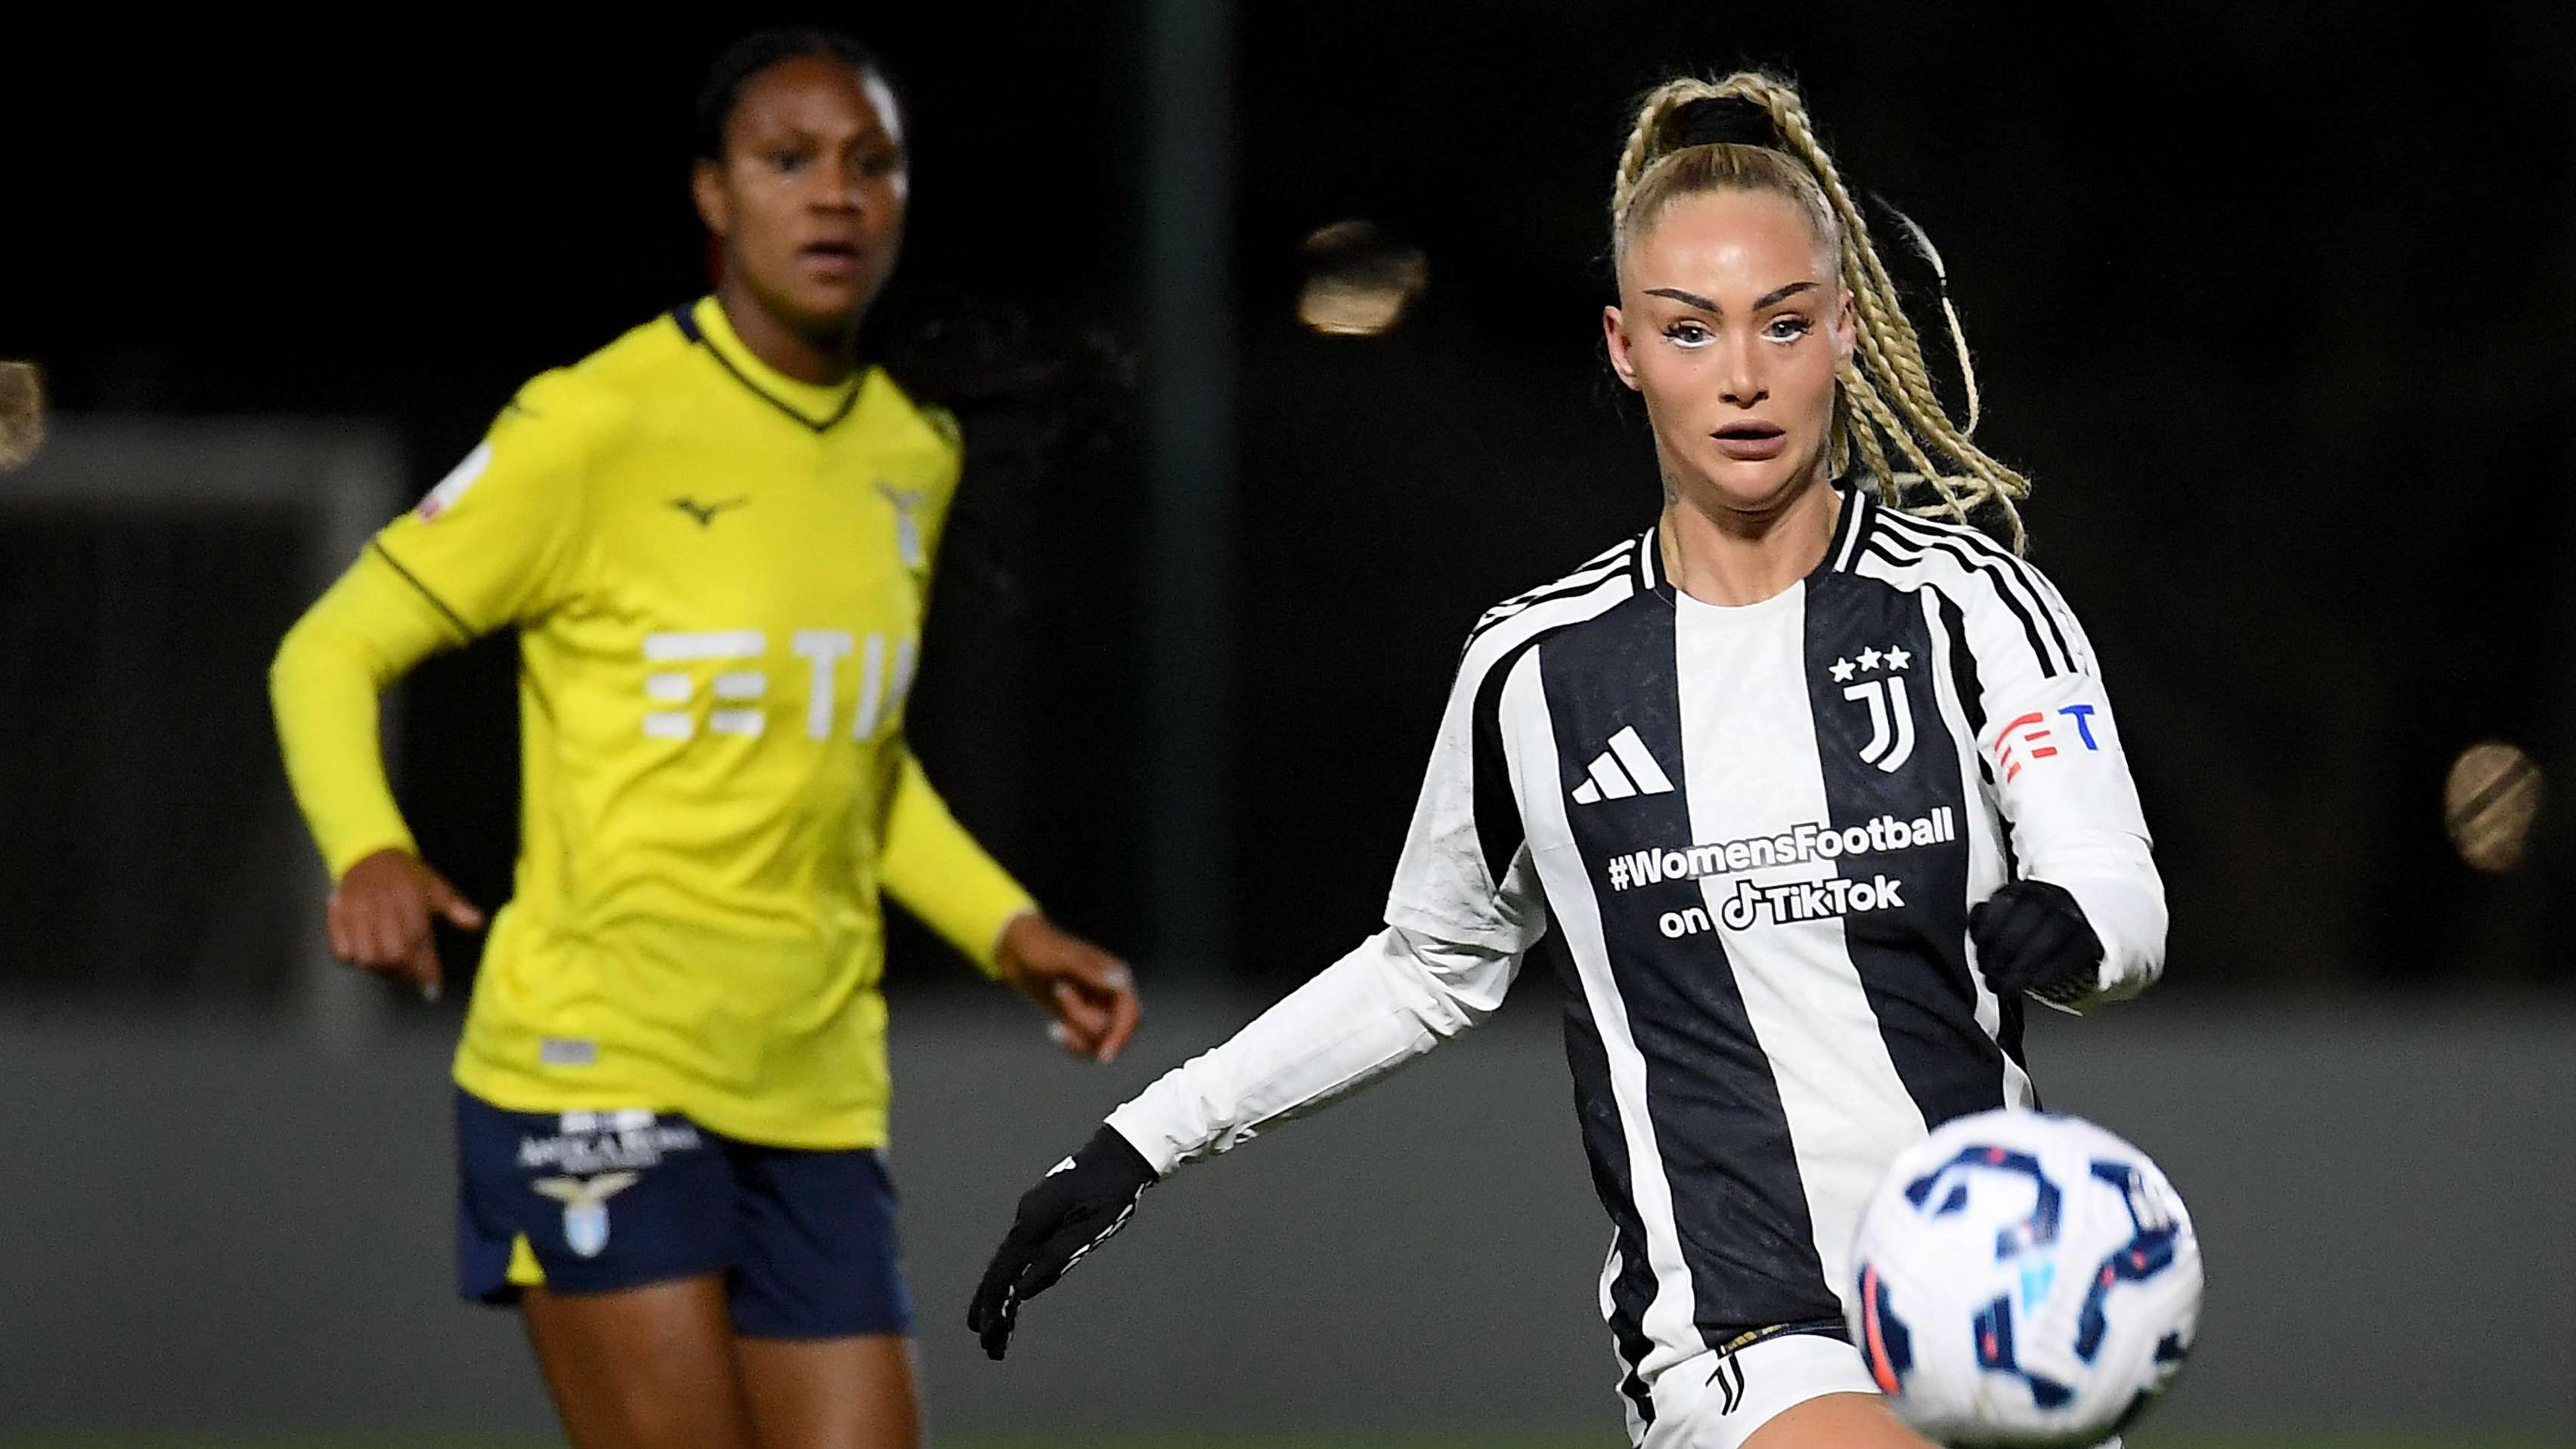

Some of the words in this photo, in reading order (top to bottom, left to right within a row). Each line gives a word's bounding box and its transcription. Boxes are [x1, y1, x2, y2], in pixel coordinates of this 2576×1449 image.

[1608, 806, 1955, 892] #WomensFootball
[1659, 906, 1711, 938] on
[1766, 875, 1906, 924] TikTok
